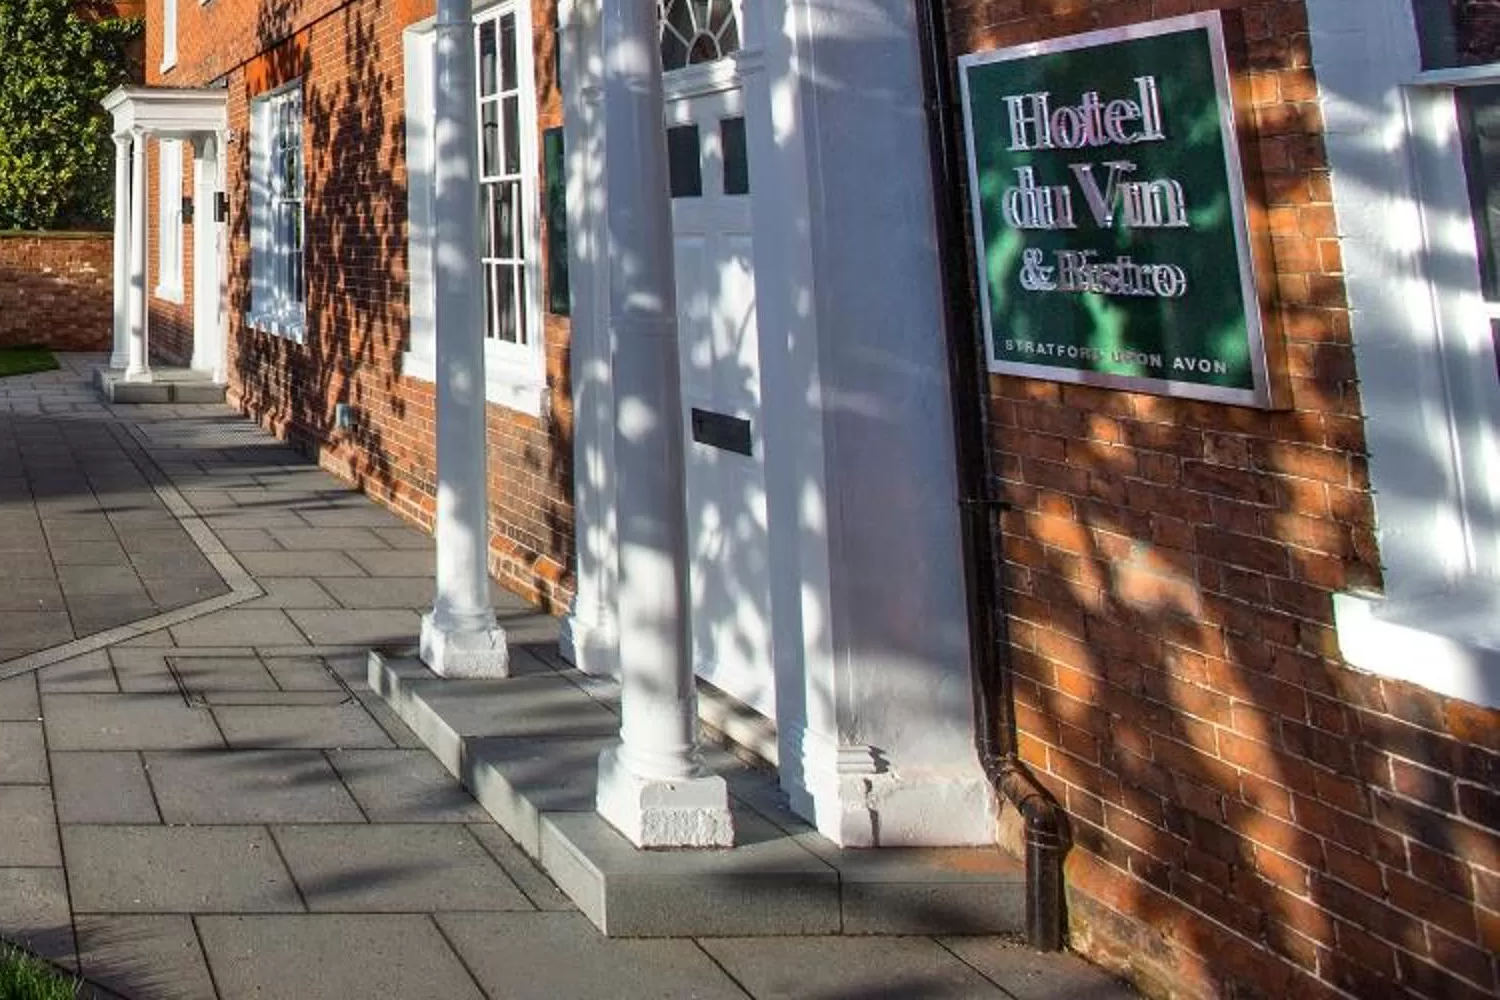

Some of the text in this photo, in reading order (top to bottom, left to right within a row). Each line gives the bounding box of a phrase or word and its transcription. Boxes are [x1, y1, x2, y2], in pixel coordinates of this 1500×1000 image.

[1002, 75, 1166, 151] Hotel
[1002, 160, 1189, 229] du Vin
[1019, 247, 1187, 297] & Bistro
[1173, 356, 1228, 375] AVON
